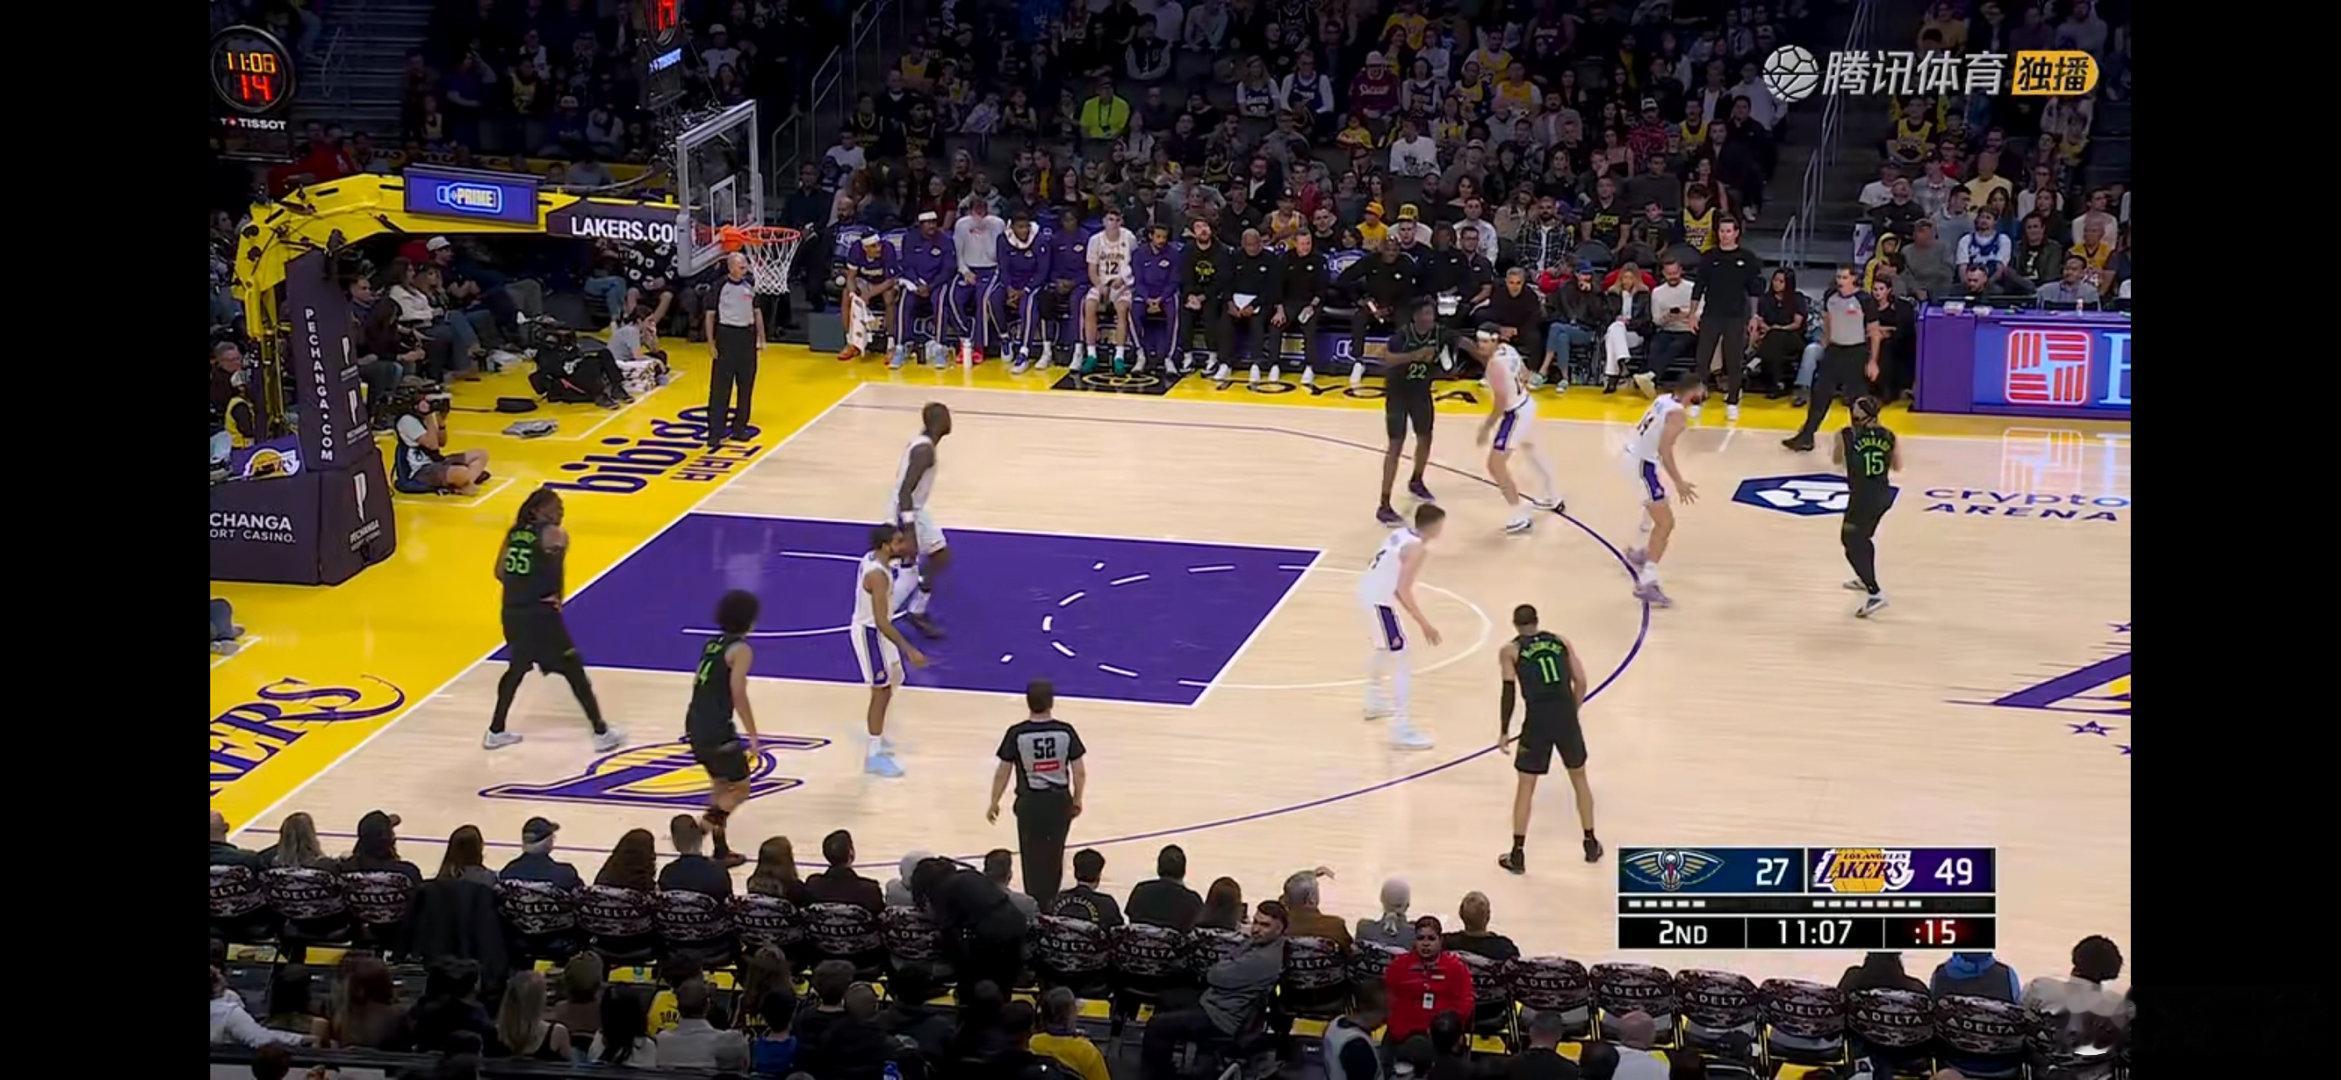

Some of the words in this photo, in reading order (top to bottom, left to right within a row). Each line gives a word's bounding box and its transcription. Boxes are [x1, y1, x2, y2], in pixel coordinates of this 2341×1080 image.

[241, 75, 272, 100] 14
[240, 117, 286, 130] TISSOT
[1407, 363, 1428, 380] 22
[1215, 379, 1479, 404] TOYOA
[1863, 451, 1885, 476] 15
[1924, 487, 2130, 507] crypto
[1922, 502, 2119, 522] ARENA
[504, 546, 531, 574] 55
[1537, 656, 1560, 683] 11
[1033, 737, 1057, 760] 52
[210, 884, 247, 898] ELTA
[282, 888, 329, 899] DELTA
[360, 892, 405, 903] DELTA
[516, 900, 560, 914] DELTA
[591, 906, 639, 918] DELTA
[667, 911, 711, 923] DELTA
[744, 915, 790, 927] DELTA
[820, 923, 865, 936] DELTA
[1052, 938, 1096, 952] DELTA
[1130, 946, 1176, 959] DELTA
[1530, 978, 1577, 990] DELTA
[1613, 985, 1663, 998] DELTA
[1700, 993, 1749, 1006] DELTA
[1785, 1003, 1835, 1018] DELTA
[1871, 1011, 1924, 1026] DELTA
[1963, 1019, 2016, 1035] DELTA
